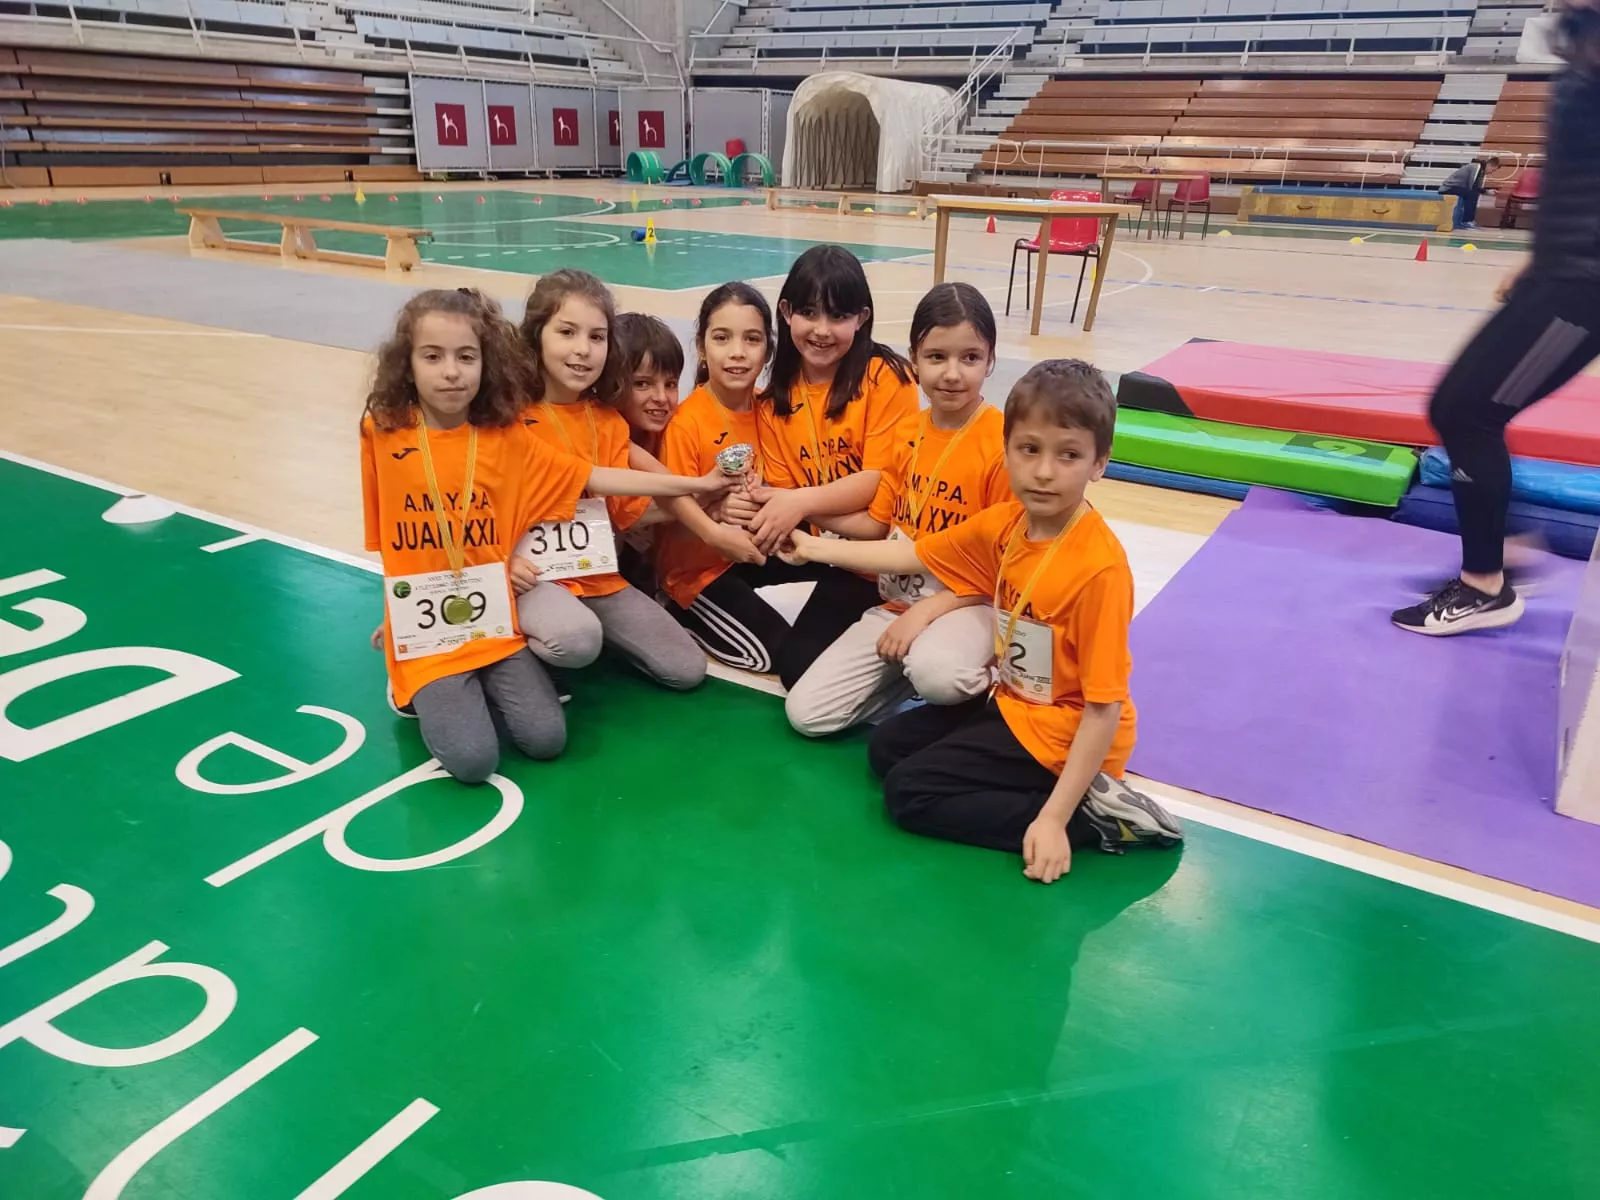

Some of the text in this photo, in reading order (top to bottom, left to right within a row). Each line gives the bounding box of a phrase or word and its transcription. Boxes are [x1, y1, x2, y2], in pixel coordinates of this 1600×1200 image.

[648, 227, 654, 238] 2
[528, 521, 589, 555] 310
[416, 591, 487, 630] 309
[174, 704, 525, 888] de
